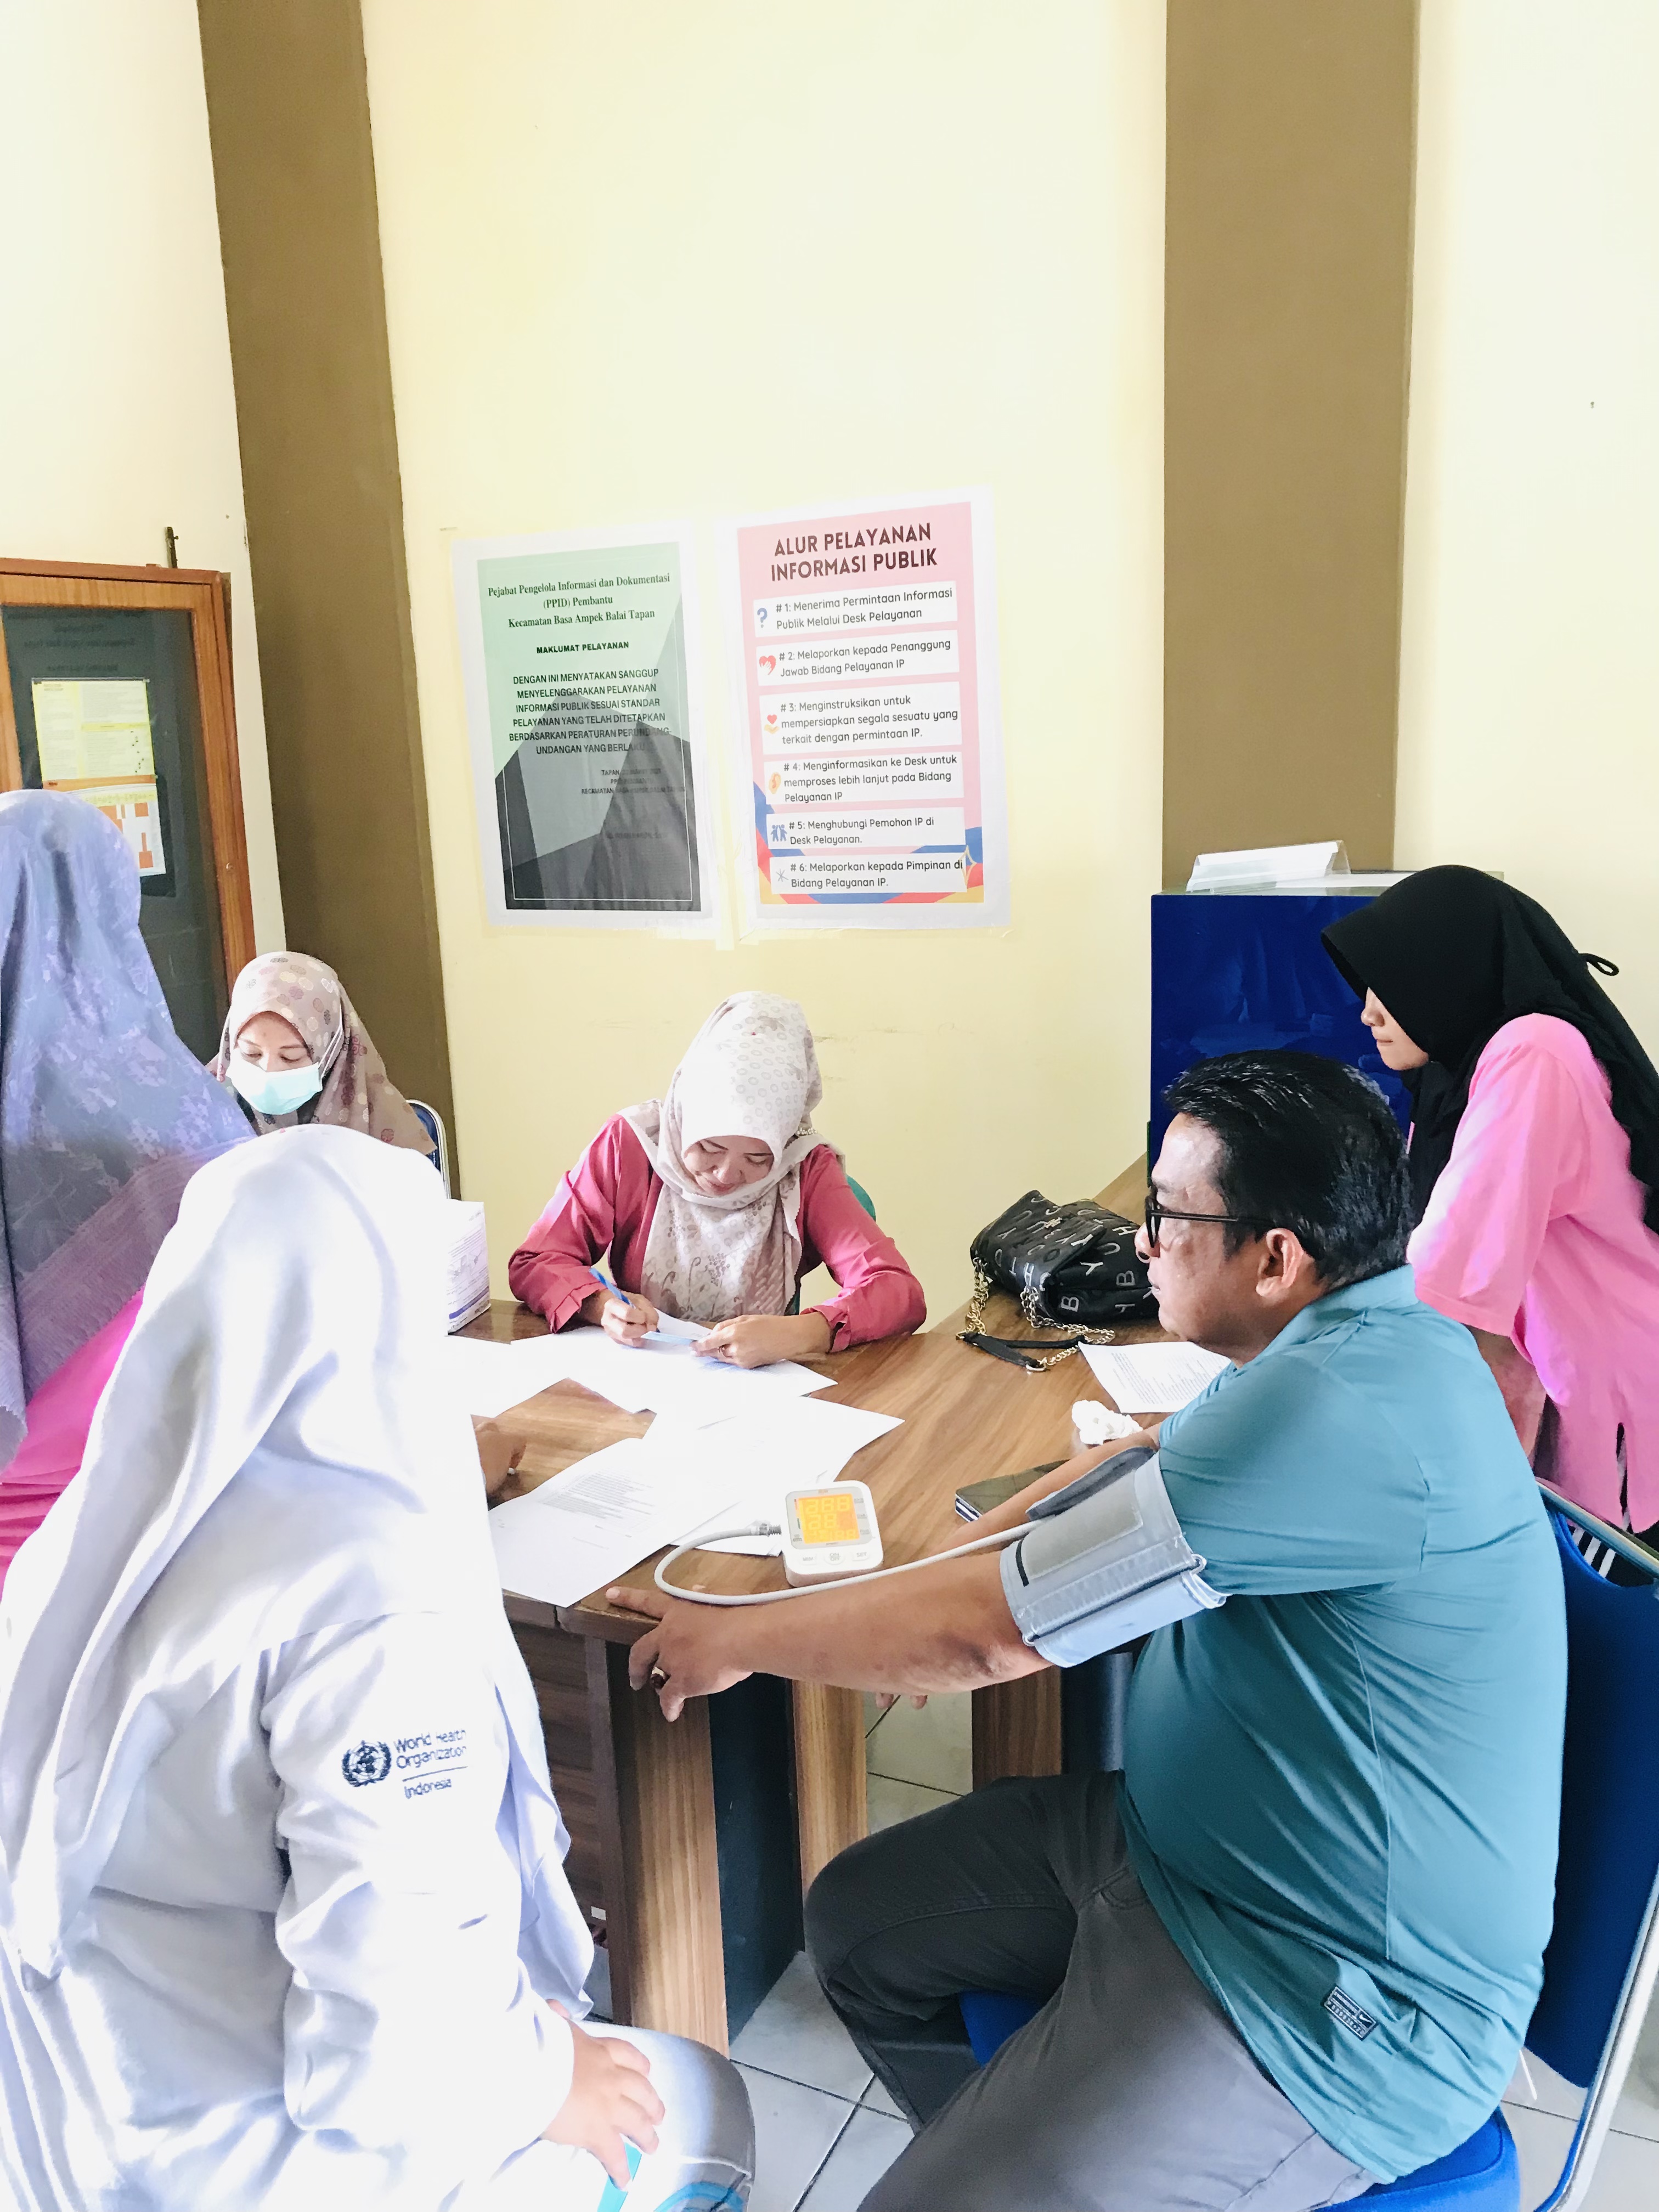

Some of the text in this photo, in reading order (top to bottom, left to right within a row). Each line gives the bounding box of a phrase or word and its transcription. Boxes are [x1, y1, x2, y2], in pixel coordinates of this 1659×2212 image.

[774, 523, 931, 556] ALUR PELAYANAN
[771, 548, 938, 581] INFORMASI PUBLIK
[488, 573, 670, 597] Pejabat Pengelola Informasi dan Dokumentasi
[543, 596, 613, 608] (PPID) Pembantu
[776, 588, 952, 612] # 1: Menerima Permintaan Informasi
[508, 610, 655, 627] Kecamatan Basa Ampek Balai Tapan
[776, 610, 922, 629] Publik Melalui Desk Pelayanan
[536, 642, 629, 653] MAKLUMAT PELAYANAN
[779, 641, 951, 661] # 2: Melaporkan kepada Penanggung
[780, 659, 905, 676] Jawab Bidang Pelayanan IP
[513, 675, 547, 684] DENGAN
[560, 671, 617, 681] MENYATAKAN
[618, 669, 659, 679] SANGGUP
[517, 684, 657, 698] MENYELENGGARAKAN PELAYANAN
[516, 698, 660, 712] INFORMASI PUBLIK SESUAI STANDAR
[780, 695, 911, 712] # 3: Menginstruksikan untuk
[512, 713, 665, 726] PELAYANAN YANG TELAH DITETAPKAN
[781, 711, 958, 729] mempersiapkan segala sesuatu yang
[509, 732, 567, 741] BERDASARKAN
[568, 730, 616, 739] PERATURAN
[782, 728, 923, 744] terkait dengan permintaan IP.
[535, 745, 582, 754] UNDANGAN
[803, 759, 888, 771] Menginformasikan
[890, 758, 902, 766] ke
[904, 756, 927, 765] Desk
[930, 755, 957, 764] untuk
[784, 772, 951, 788] memproses lebih lanjut pada Bidang
[785, 792, 843, 803] Pelayanan IP
[808, 819, 867, 831] Menghubungi
[870, 818, 912, 827] Pemohon
[915, 817, 923, 826] IP
[926, 816, 934, 825] di
[789, 836, 862, 845] Desk Pelayanan.
[790, 859, 963, 873] # 6: Melaporkan kepada Pimpinan di
[791, 878, 888, 889] Bidang Pelayanan IP.
[394, 1733, 431, 1753] World
